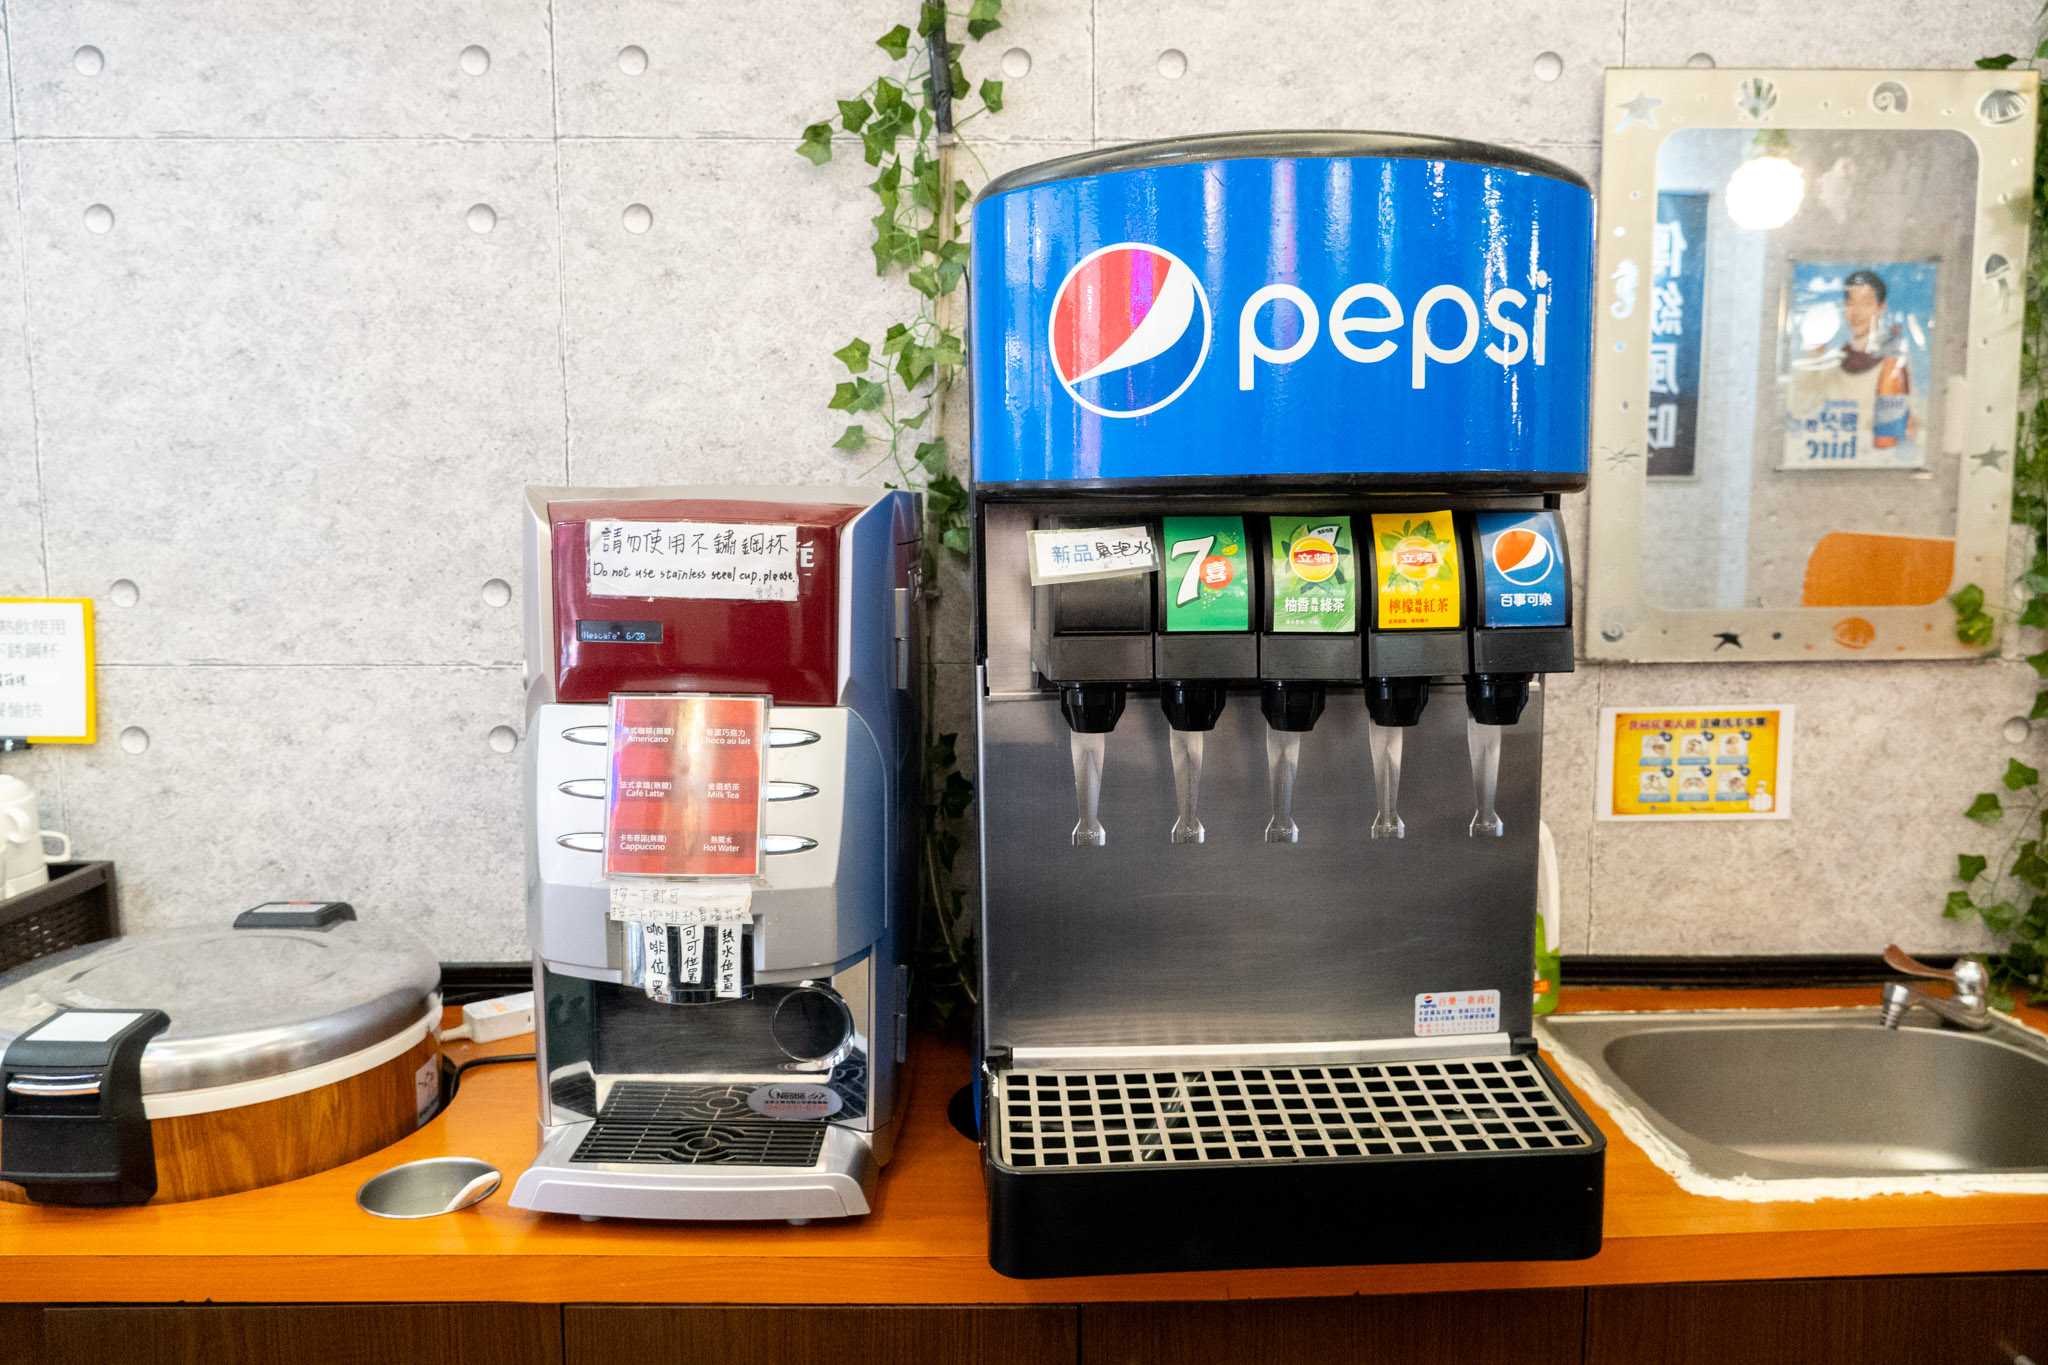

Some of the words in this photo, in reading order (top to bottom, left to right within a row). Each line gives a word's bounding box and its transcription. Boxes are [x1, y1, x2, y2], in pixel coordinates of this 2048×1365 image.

[1239, 269, 1547, 391] pepsi
[601, 527, 789, 555] 請勿使用不鏽鋼杯
[1297, 551, 1331, 564] 立頓
[1400, 551, 1434, 564] 立頓
[593, 562, 608, 577] Do
[611, 566, 630, 577] not
[635, 568, 655, 578] use
[660, 567, 706, 580] stainless
[712, 566, 736, 582] steel
[1500, 593, 1552, 608] 百事可樂
[627, 734, 669, 744] Americano
[701, 736, 725, 745] Choco
[738, 736, 751, 745] lait
[626, 788, 644, 797] Café
[645, 789, 665, 798] Latte
[707, 790, 725, 799] Milk
[725, 791, 740, 799] Tea
[619, 842, 666, 852] Cappuccino
[703, 844, 717, 852] Hot
[717, 844, 740, 852] Water
[612, 884, 680, 905] 按一下即可
[646, 922, 668, 996] 咖啡位置
[682, 924, 701, 983] 可可位置
[720, 928, 736, 993] 熱水位置
